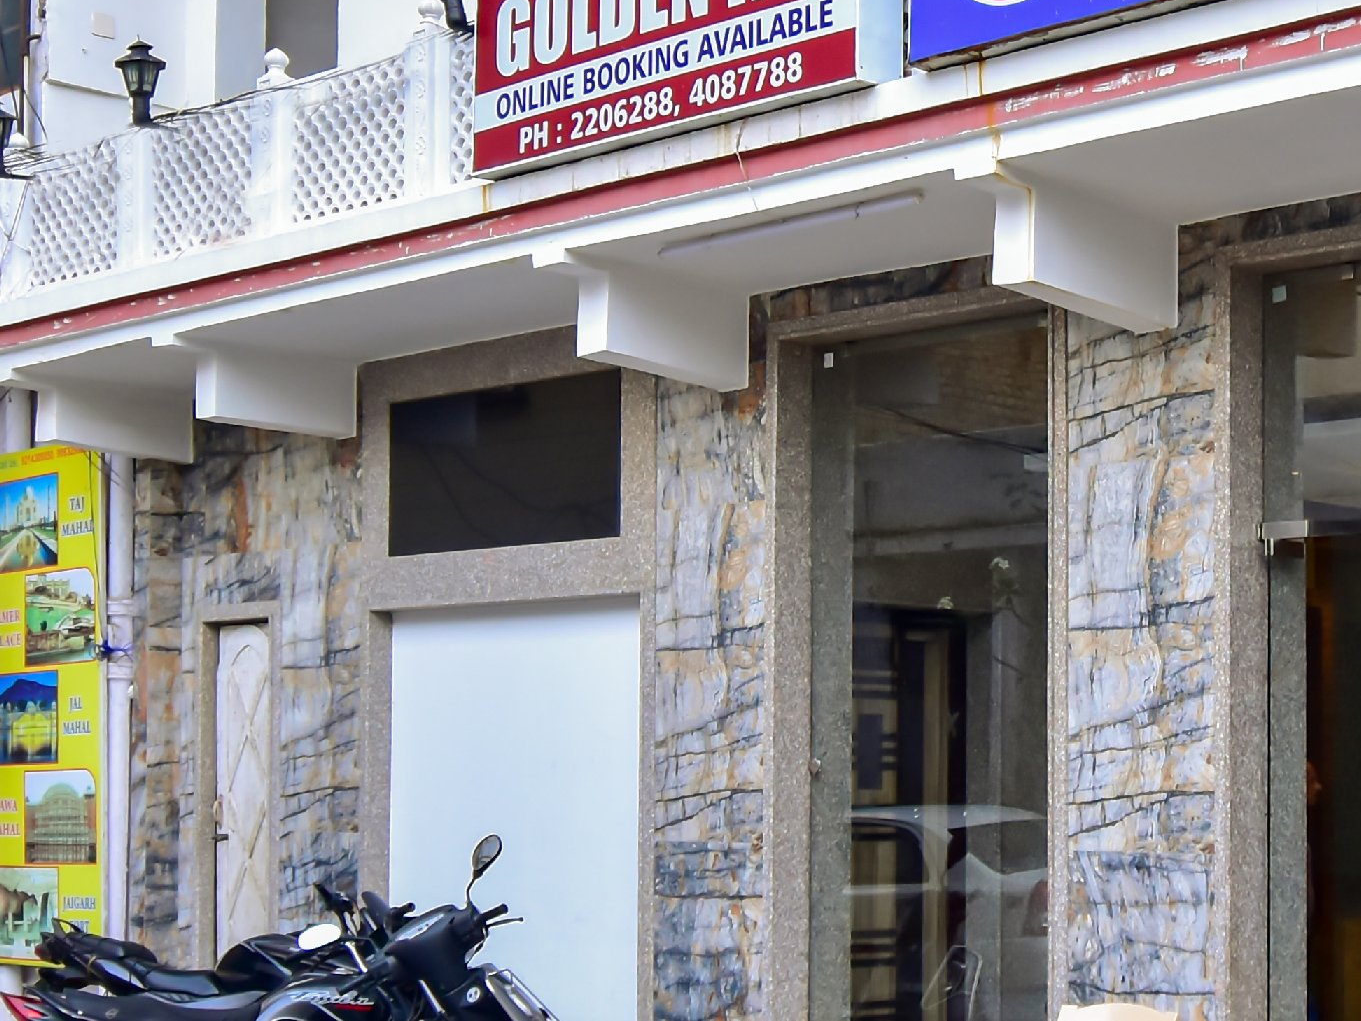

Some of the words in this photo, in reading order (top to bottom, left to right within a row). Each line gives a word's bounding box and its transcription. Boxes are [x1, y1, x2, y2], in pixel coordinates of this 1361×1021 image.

[496, 73, 575, 120] ONLINE
[583, 40, 689, 93] BOOKING
[570, 86, 680, 139] 2206288,
[689, 51, 803, 108] 4087788
[69, 496, 84, 512] TAJ
[62, 520, 94, 536] MAHAL
[68, 697, 82, 714] JAL
[63, 721, 91, 735] MAHAL
[62, 896, 96, 912] JAIGARH
